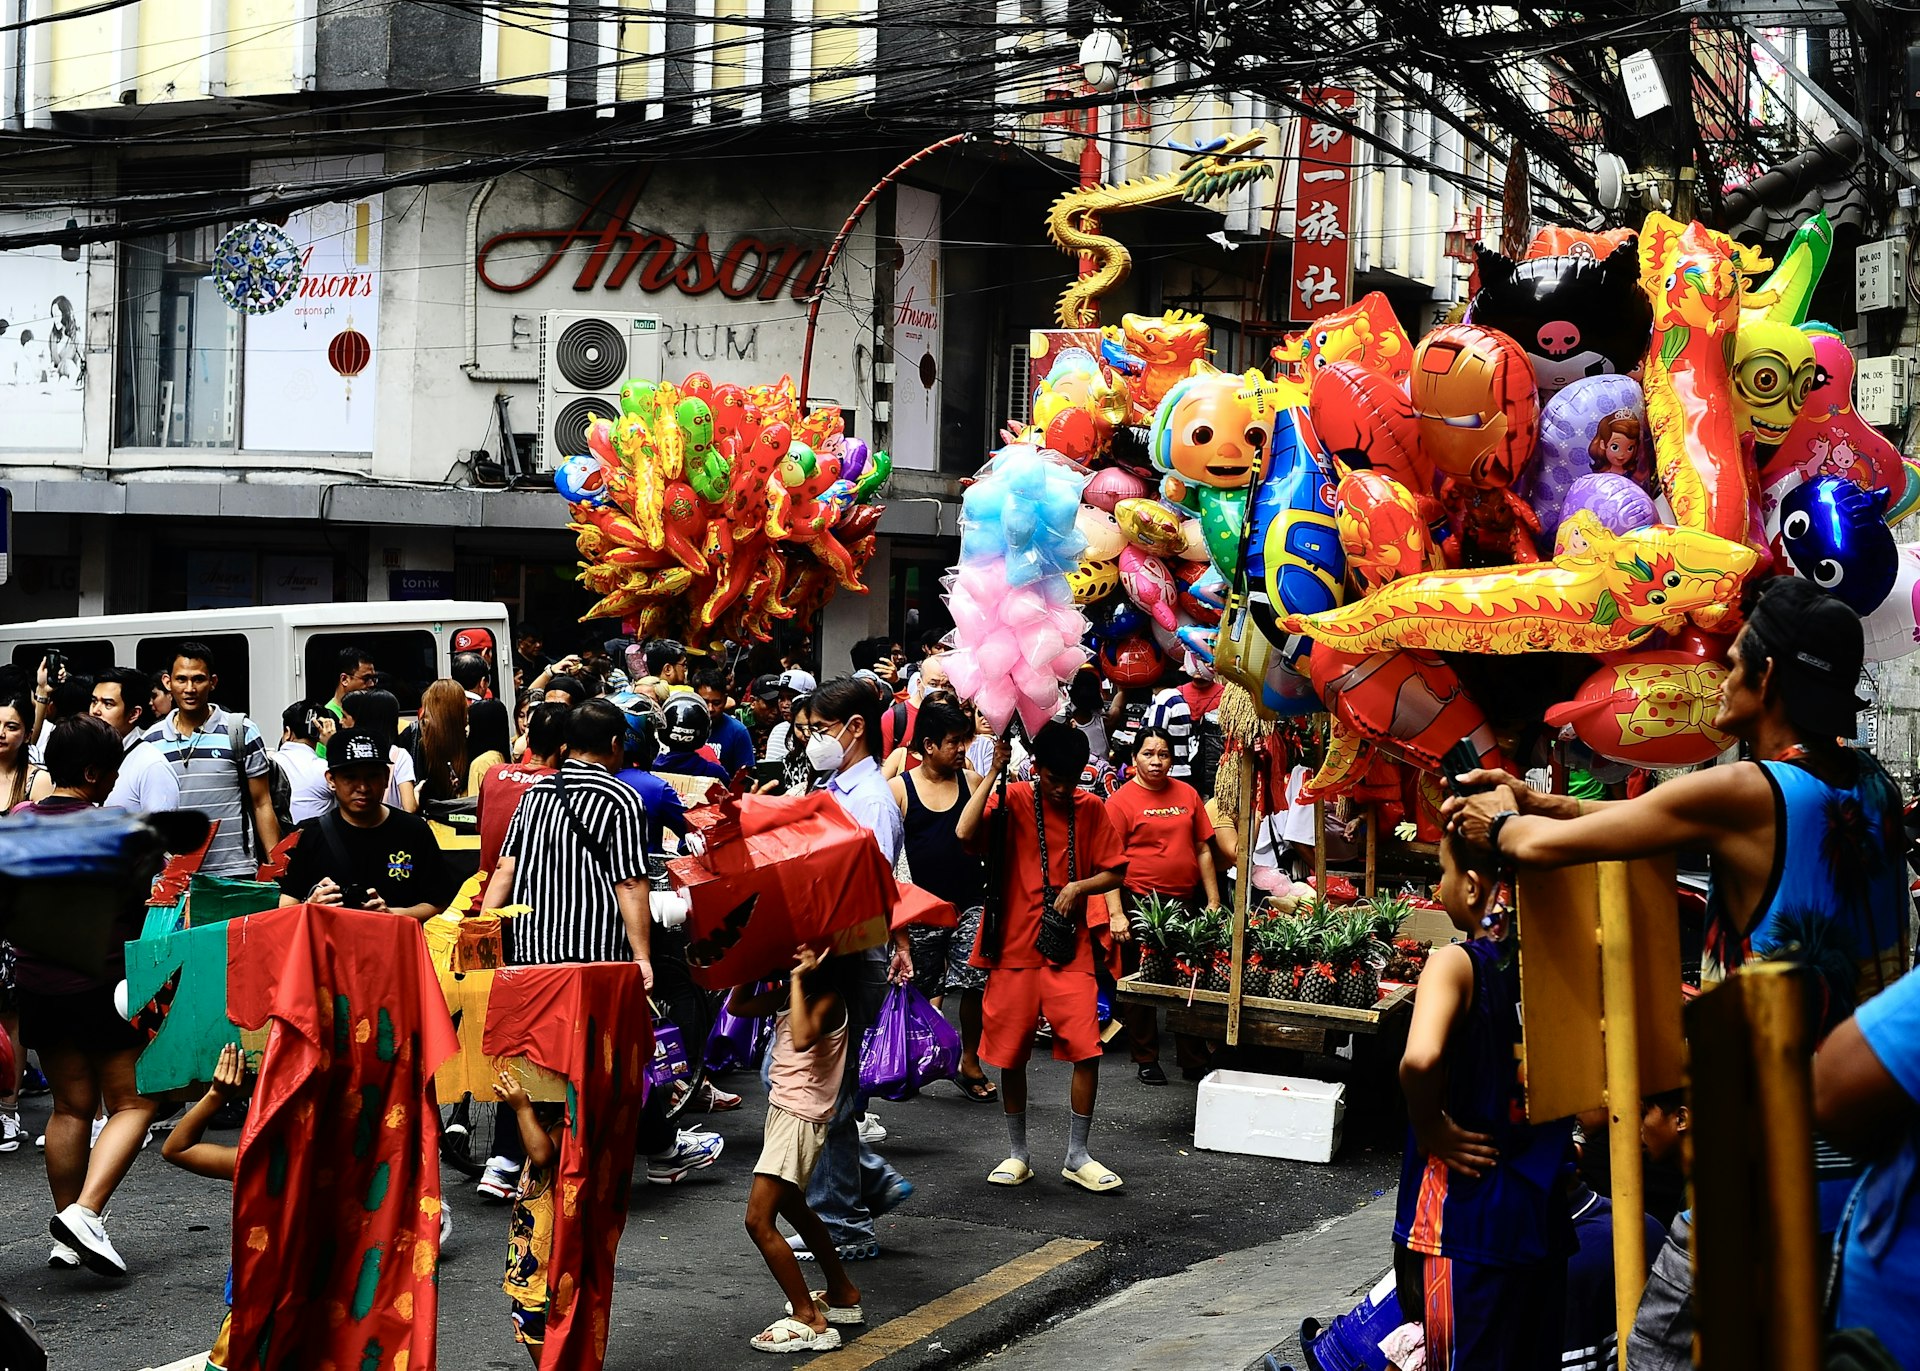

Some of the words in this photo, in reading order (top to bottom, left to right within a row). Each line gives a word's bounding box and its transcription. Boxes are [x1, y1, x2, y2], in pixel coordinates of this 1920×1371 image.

[294, 303, 336, 319] ansons.ph
[635, 320, 656, 329] kolin
[49, 565, 77, 591] LG
[402, 575, 441, 588] tonik
